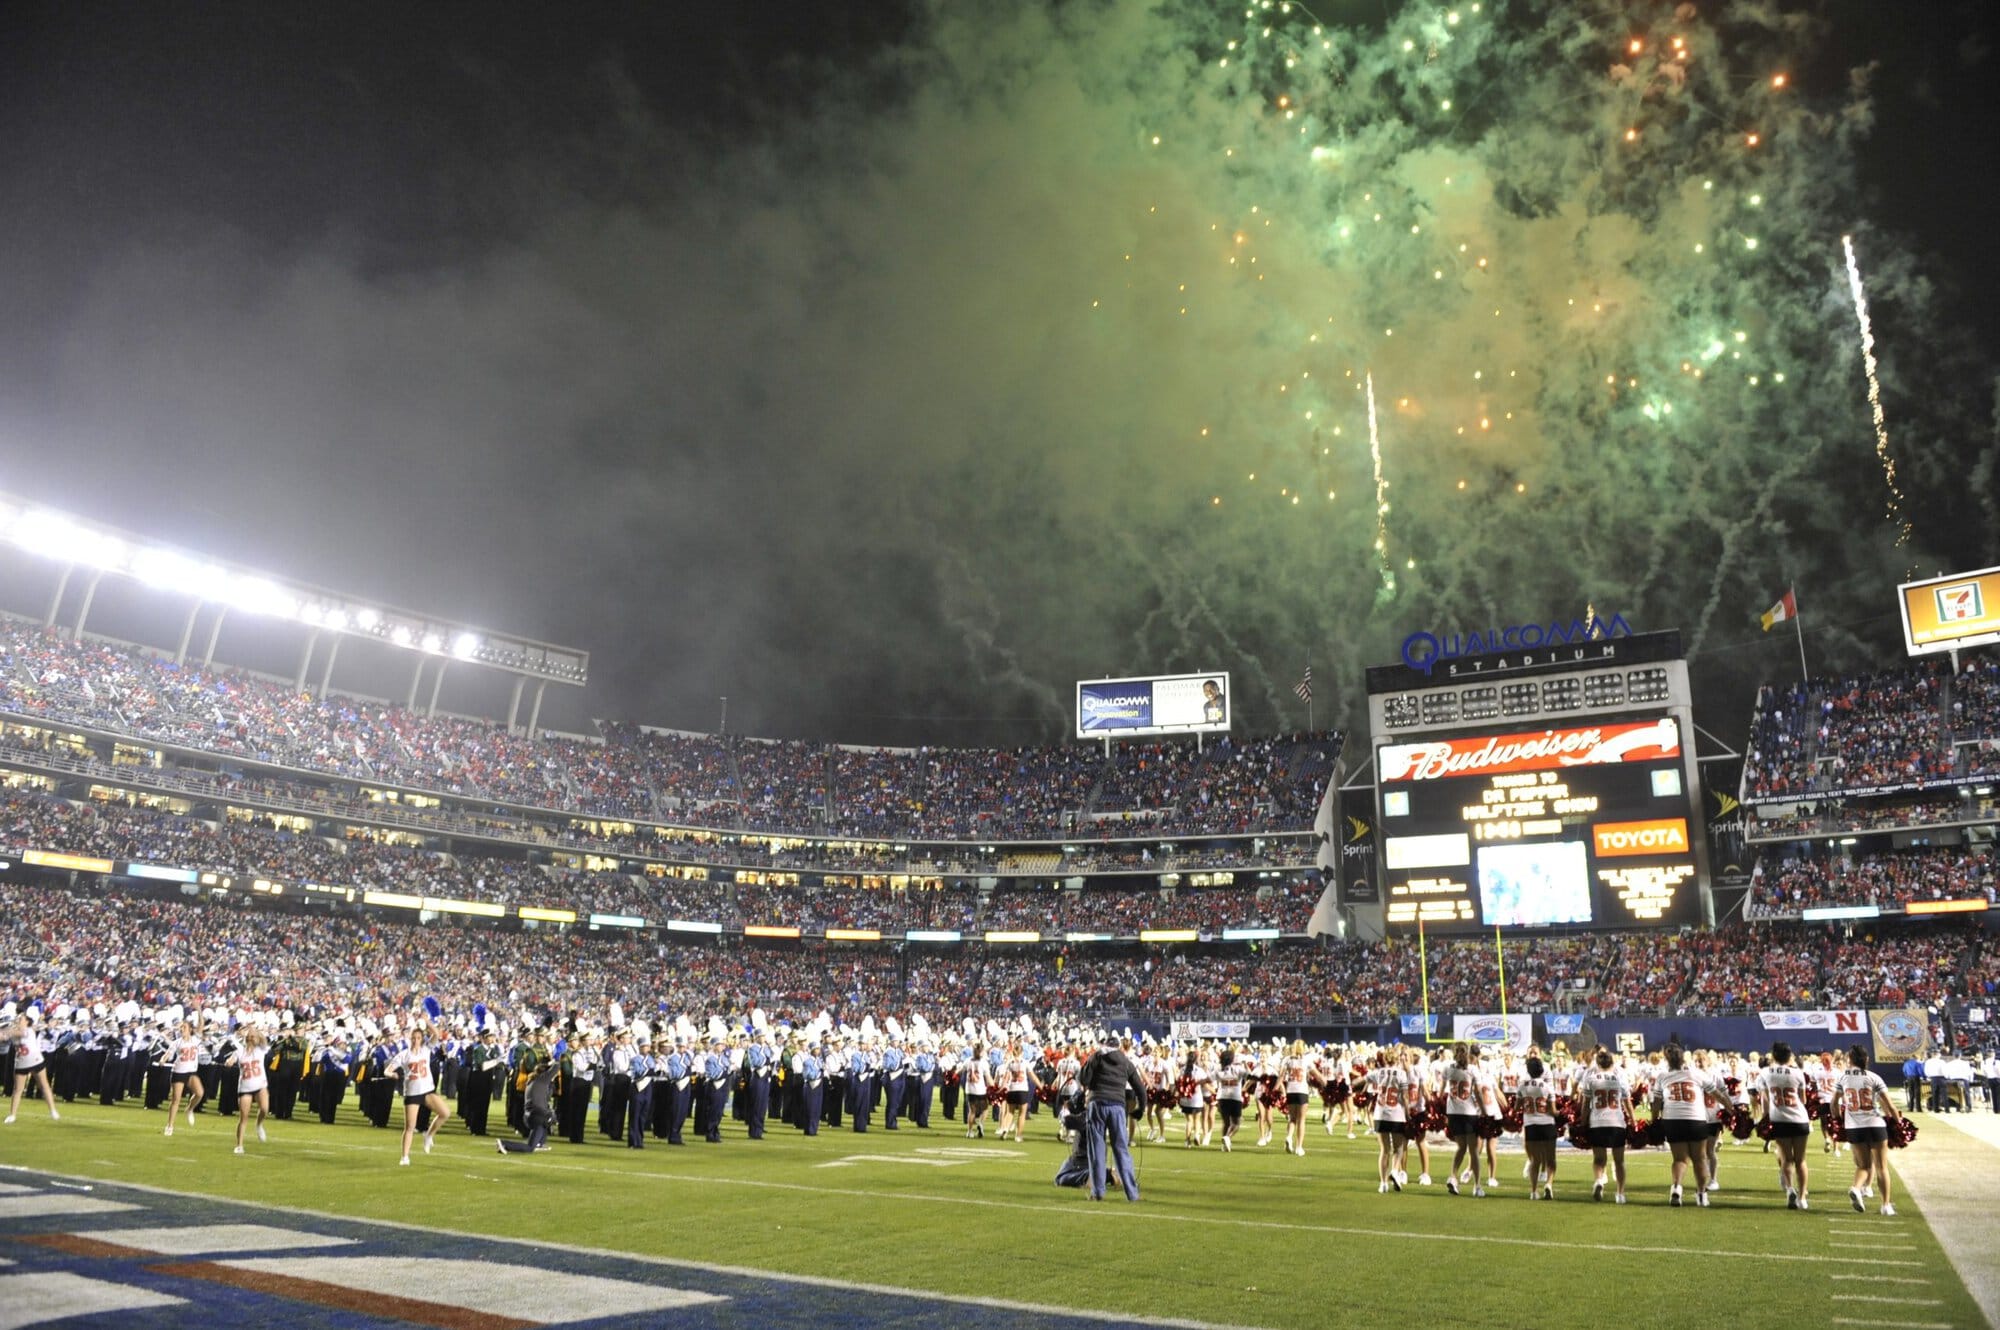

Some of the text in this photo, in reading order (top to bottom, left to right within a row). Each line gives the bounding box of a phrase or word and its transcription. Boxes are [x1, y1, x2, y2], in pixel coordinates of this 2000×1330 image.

[1401, 613, 1632, 676] QUALCOMM
[1450, 645, 1615, 672] STADIUM
[1084, 696, 1149, 711] QUALCOMM
[1410, 730, 1602, 780] Budweiser
[1509, 784, 1569, 802] PEPPER
[1553, 796, 1598, 814] SHOW
[1598, 827, 1684, 849] TOYOTA
[1708, 821, 1745, 834] Sprint
[1343, 844, 1373, 856] Sprint
[1177, 1023, 1193, 1039] A
[1836, 1012, 1859, 1031] N
[1594, 1088, 1620, 1109] 36
[1667, 1081, 1697, 1102] 36
[1770, 1086, 1798, 1107] 36
[1845, 1087, 1873, 1111] 36
